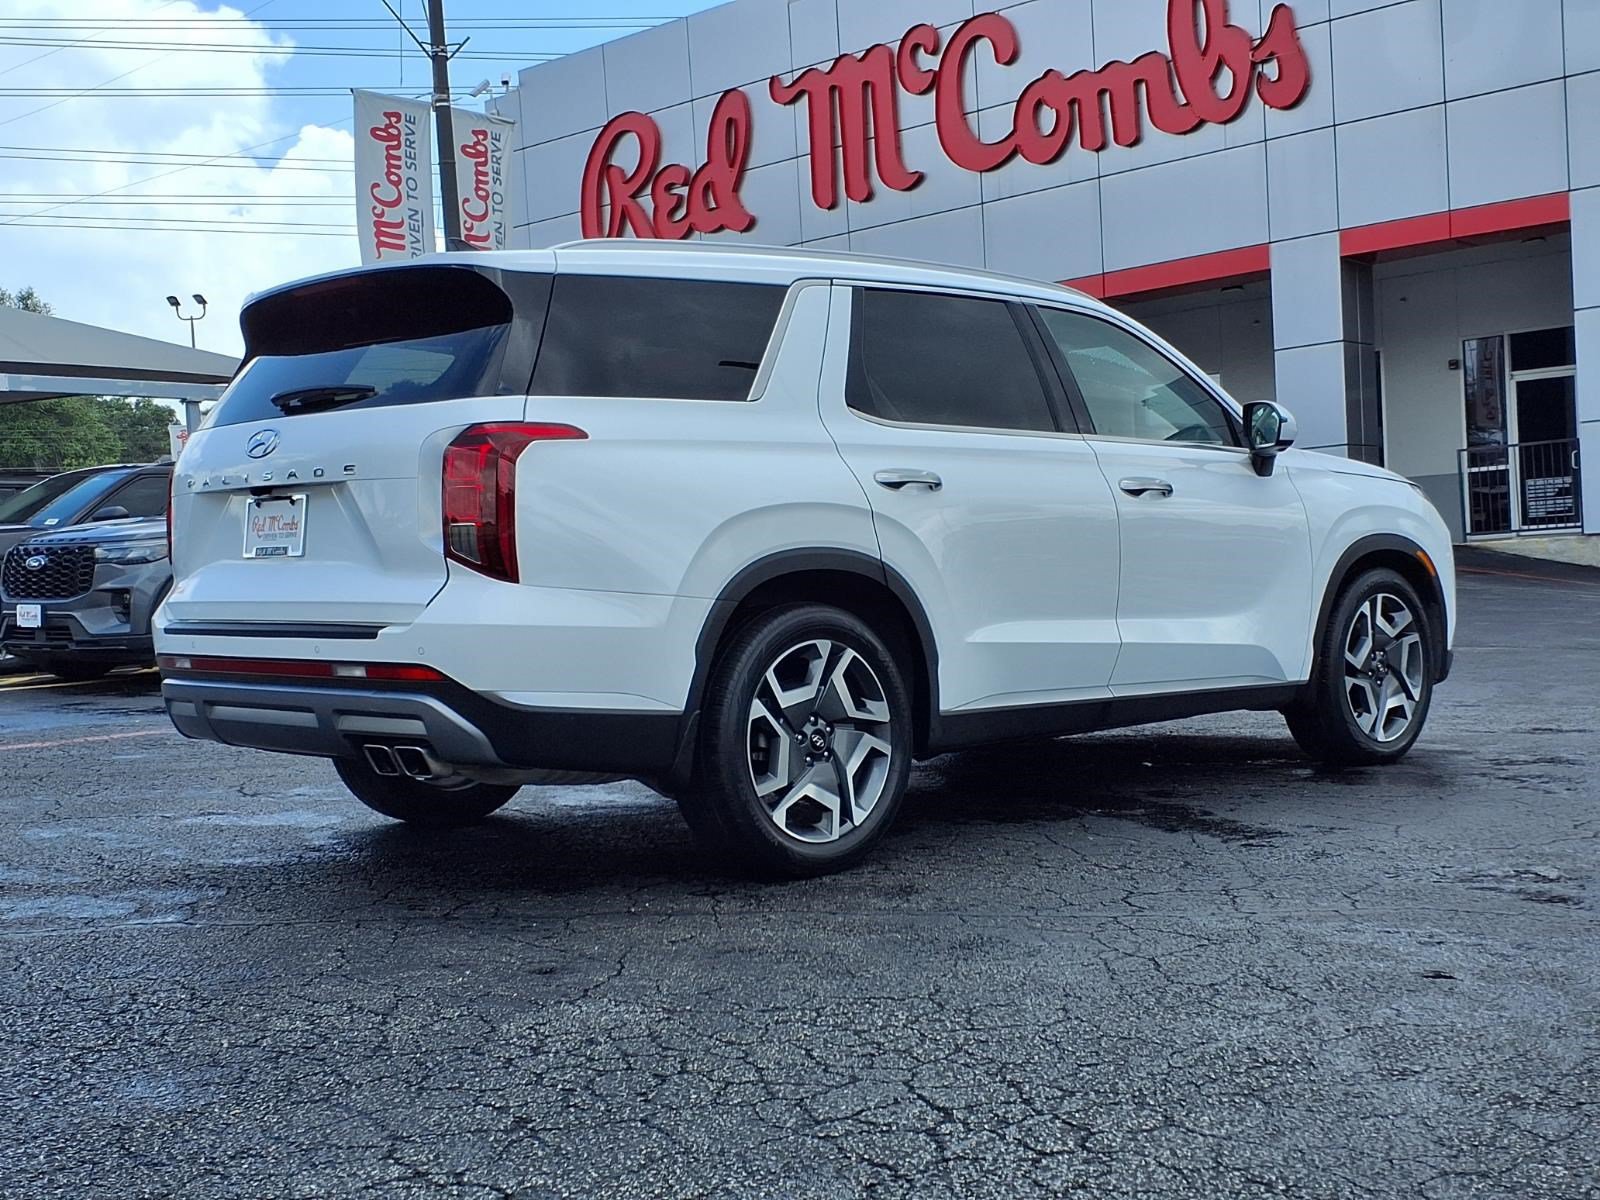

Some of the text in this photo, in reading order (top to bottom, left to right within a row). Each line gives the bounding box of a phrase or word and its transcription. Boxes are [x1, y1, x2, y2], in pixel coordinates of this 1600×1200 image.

[490, 130, 504, 186] SERVE
[580, 0, 1311, 240] Red McCombs
[369, 111, 406, 259] McCombs
[404, 113, 421, 259] RIVEN TO SERVE
[491, 192, 504, 215] TO
[187, 464, 356, 489] PALISADE
